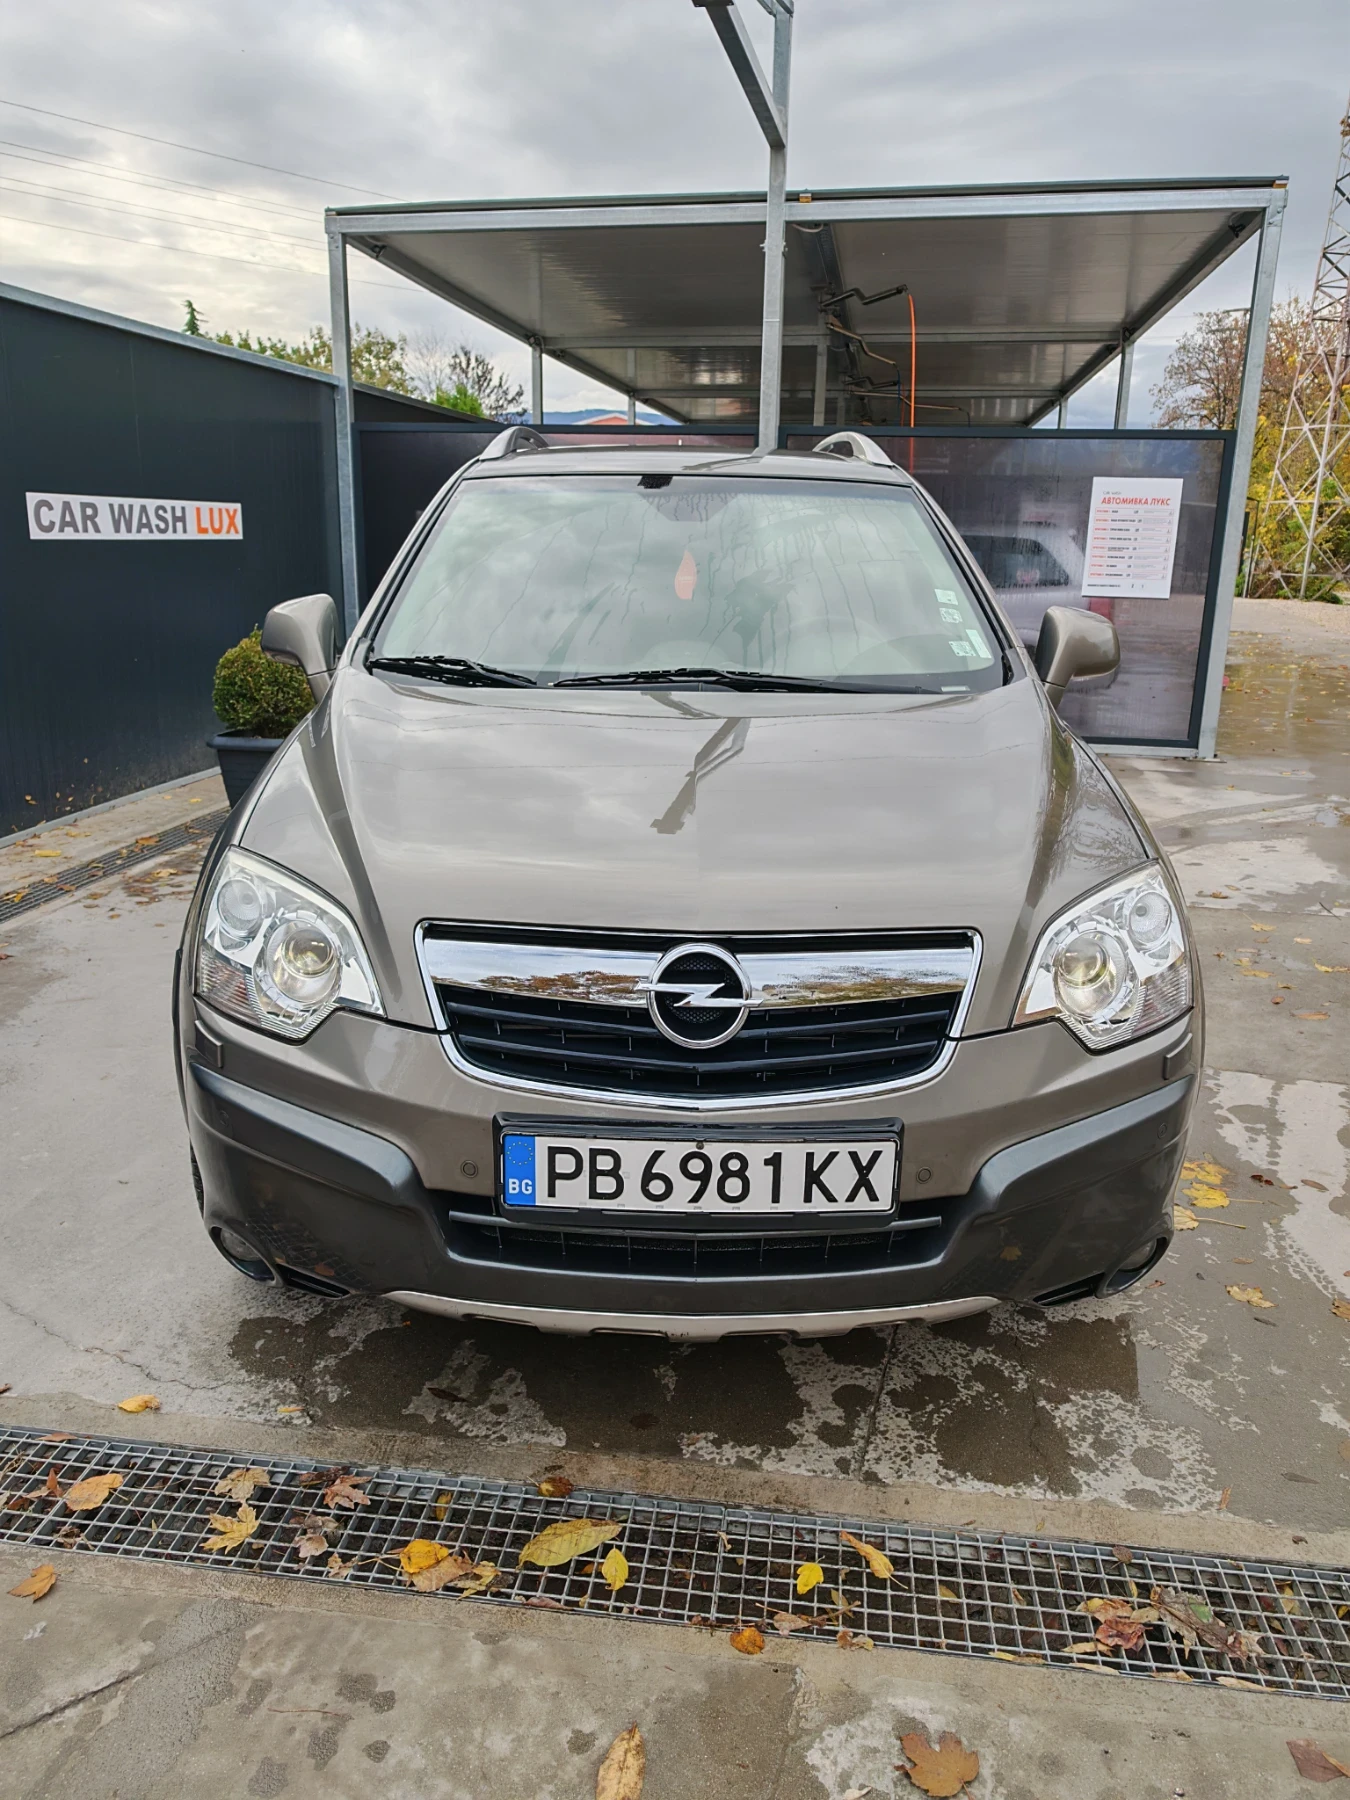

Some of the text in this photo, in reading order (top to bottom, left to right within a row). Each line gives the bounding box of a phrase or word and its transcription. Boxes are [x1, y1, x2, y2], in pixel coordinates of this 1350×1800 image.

[1101, 497, 1171, 506] АВТОМИВКА ЛУКС
[33, 499, 239, 535] CAR WASH LUX
[508, 1178, 533, 1195] BG
[547, 1145, 884, 1204] PB 6981 KX
